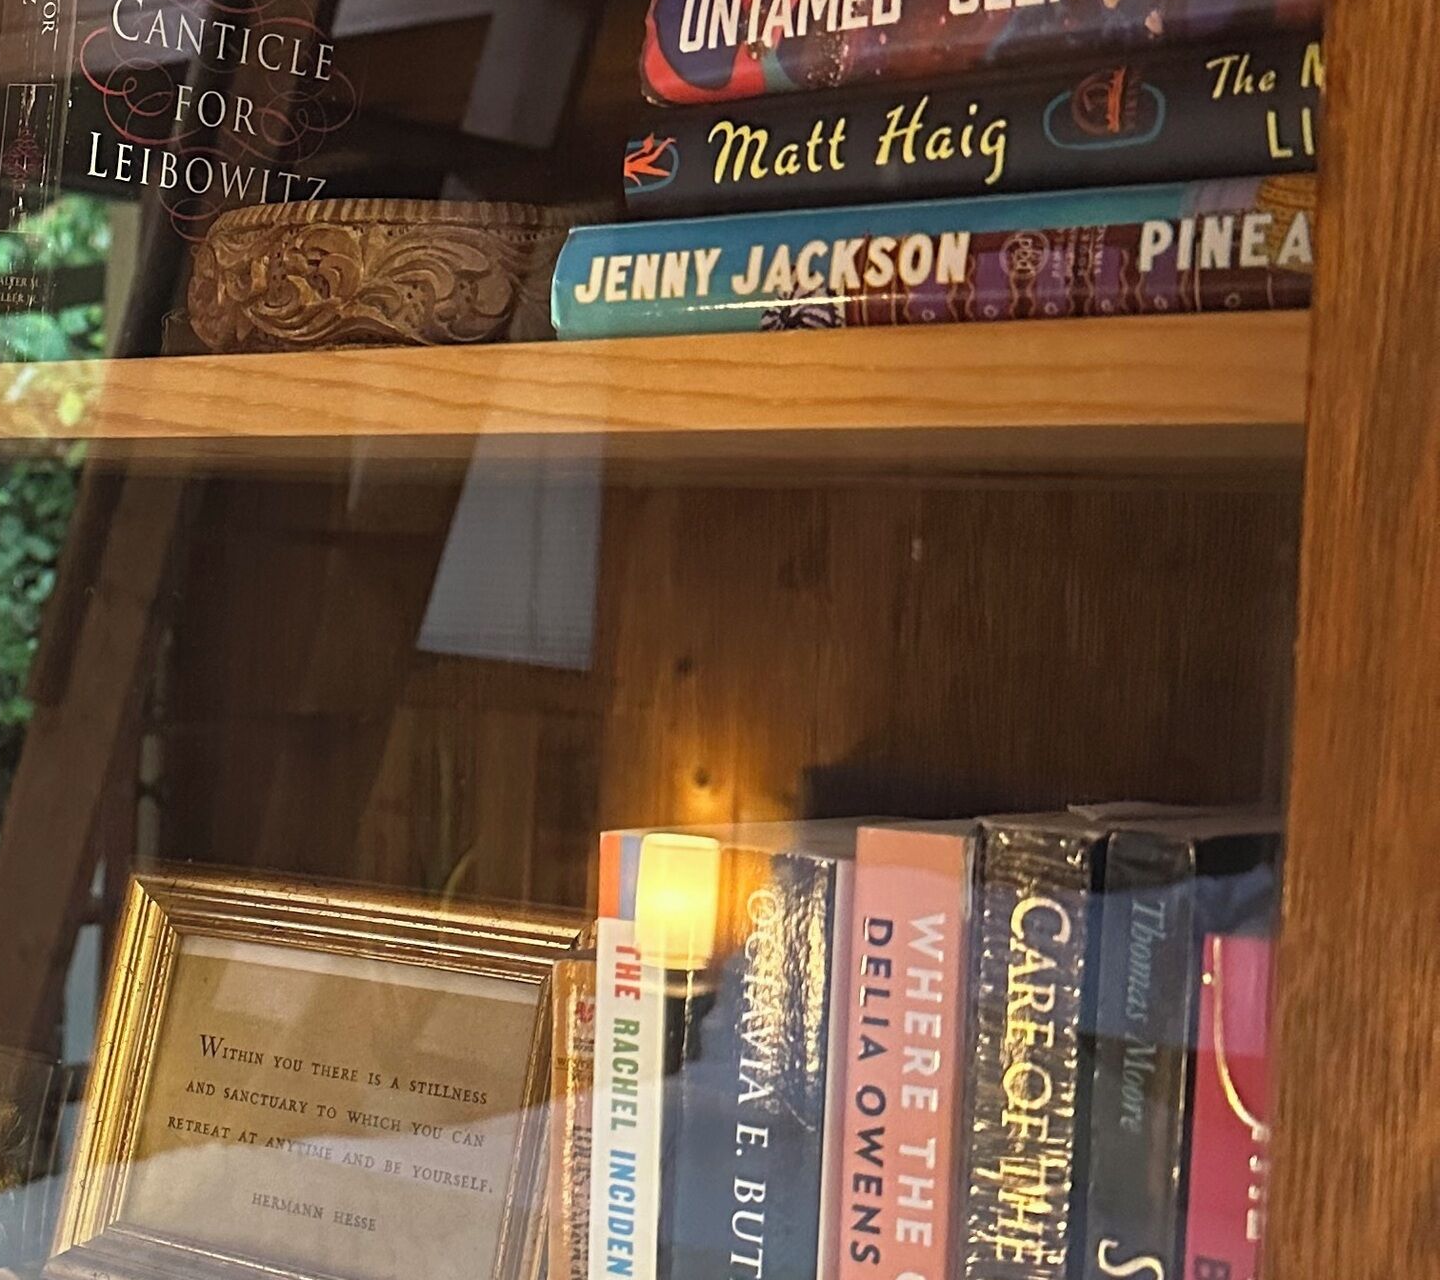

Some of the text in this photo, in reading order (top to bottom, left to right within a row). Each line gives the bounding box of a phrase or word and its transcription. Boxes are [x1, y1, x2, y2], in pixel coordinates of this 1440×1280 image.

[175, 84, 258, 136] FOR
[1205, 53, 1276, 100] The
[87, 132, 327, 204] LEIBOWITZ
[708, 95, 1007, 186] Matt Haig
[574, 247, 722, 304] JENNY
[732, 231, 971, 297] JACKSON
[614, 944, 642, 1003] THE
[736, 889, 777, 1105] OCTAVIA
[900, 911, 946, 1113] WHERE
[1006, 897, 1071, 1050] CARE
[1119, 898, 1166, 1135] Thomas Moore
[273, 1056, 303, 1073] YOU
[311, 1063, 359, 1083] THERE
[368, 1072, 382, 1087] IS
[389, 1076, 400, 1090] A
[408, 1078, 488, 1105] STILLNESS
[610, 1017, 641, 1132] RACHEL
[850, 917, 894, 1266] DELIA OWENS
[1001, 1062, 1053, 1142] OF
[186, 1080, 485, 1149] AND SANCTUARY TO WHICH YOU CAN
[735, 1126, 769, 1158] E.
[167, 1115, 493, 1194] RETREAT AT ANYTIME AND BE YOURSELF.
[896, 1138, 937, 1250] THE
[251, 1191, 377, 1232] HERMANN HESSE
[996, 1157, 1048, 1265] THE
